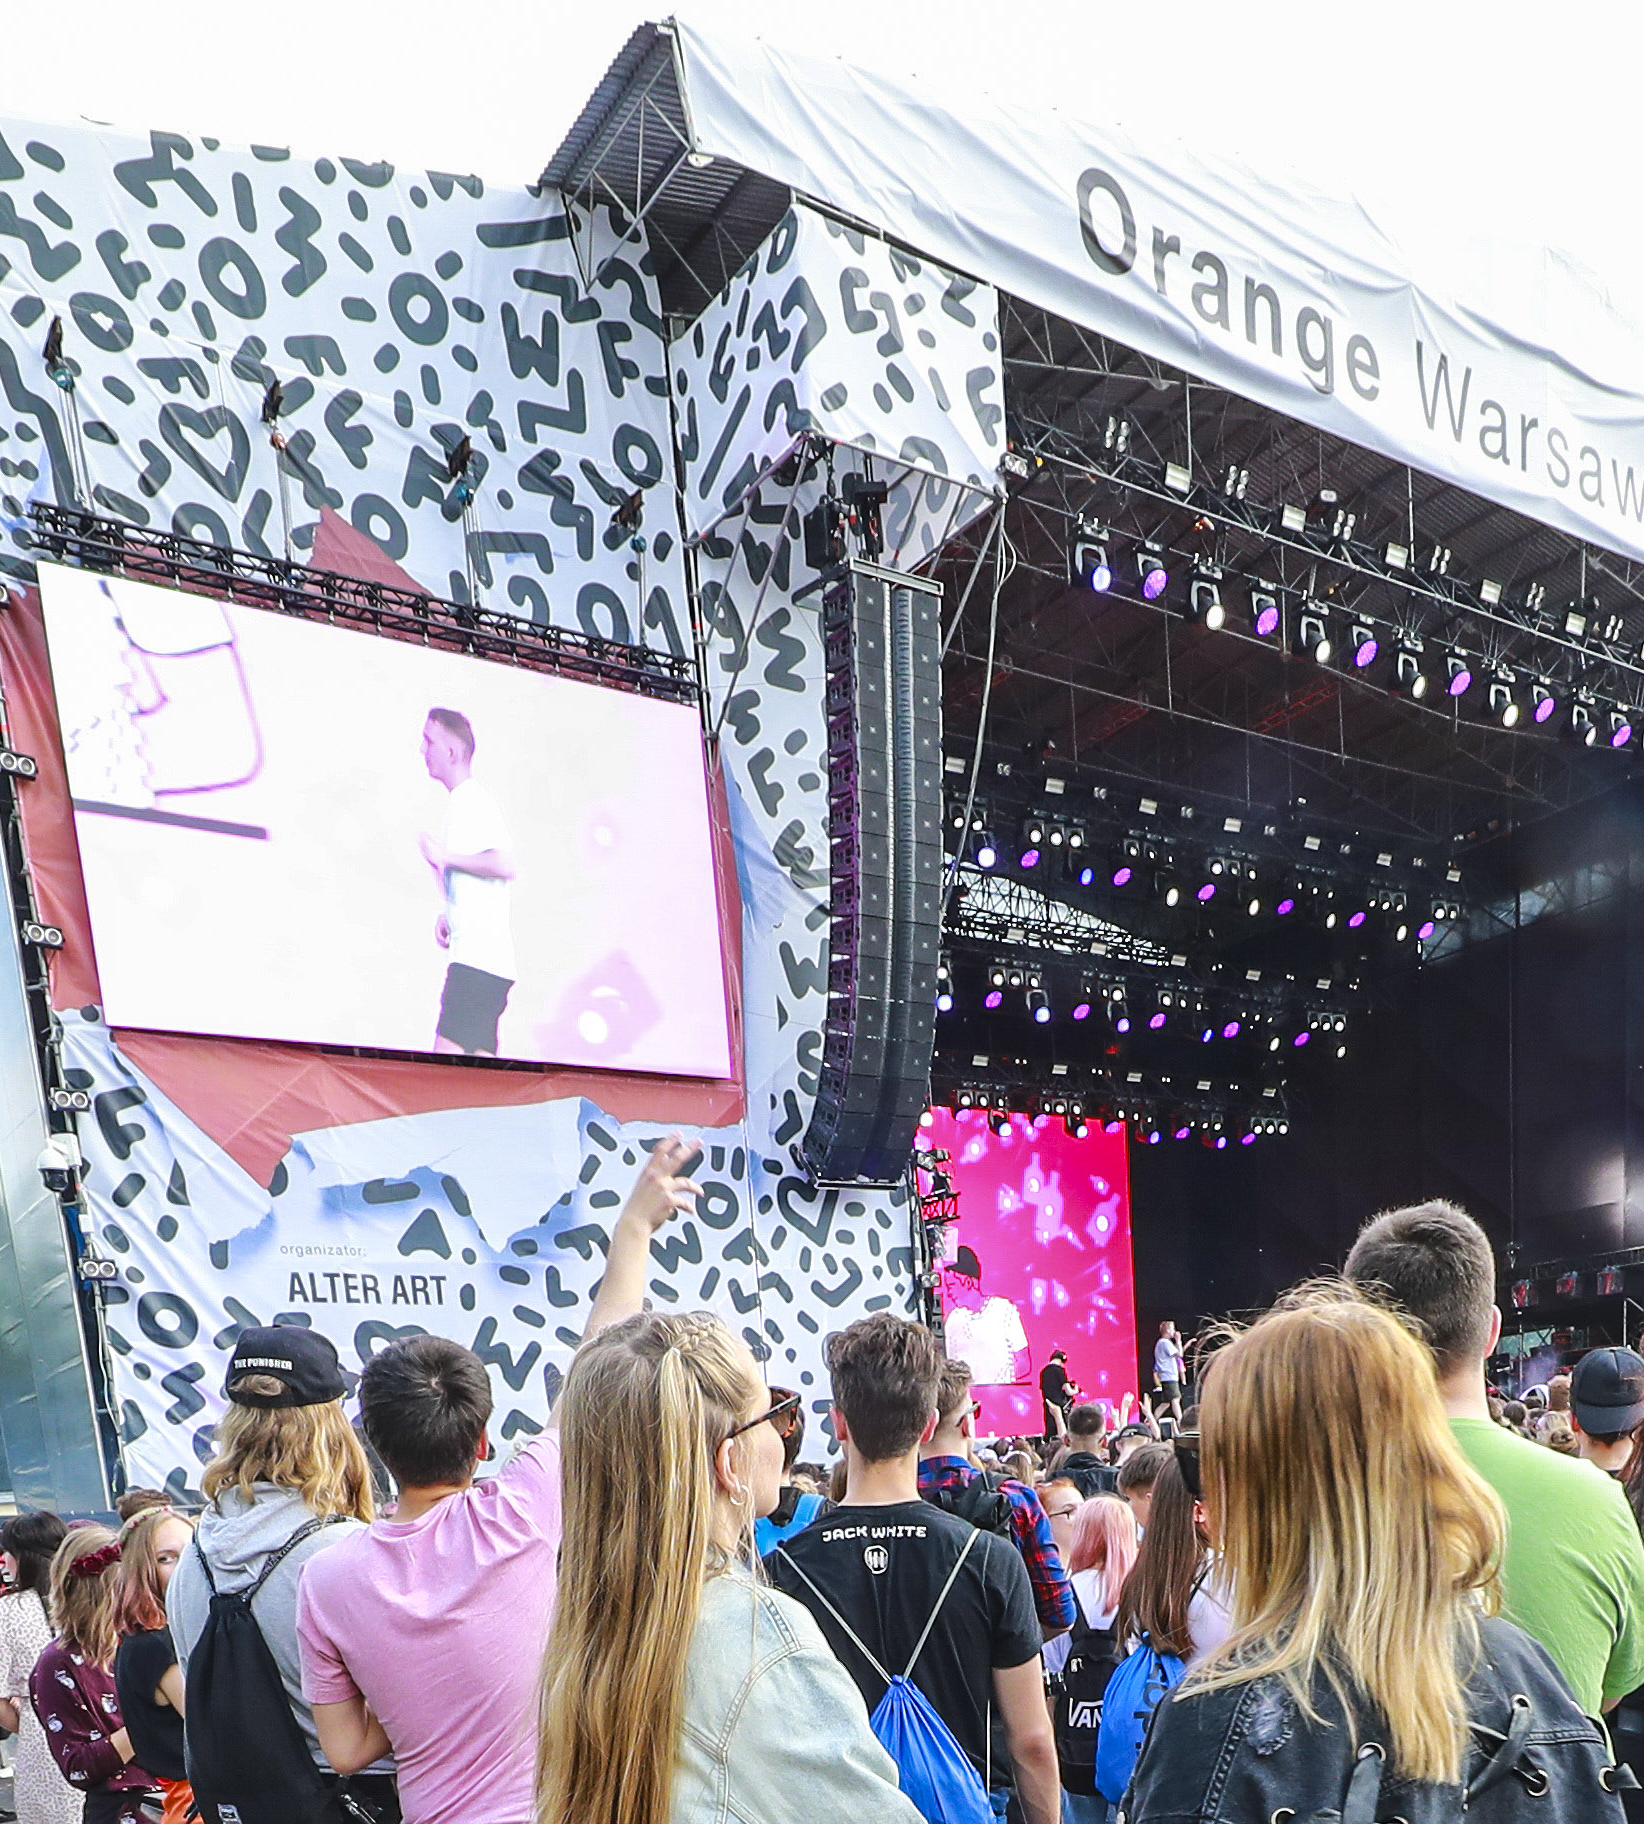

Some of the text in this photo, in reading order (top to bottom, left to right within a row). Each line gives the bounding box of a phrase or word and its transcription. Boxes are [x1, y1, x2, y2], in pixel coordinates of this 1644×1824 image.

[1075, 167, 1381, 402] Orange
[280, 1244, 367, 1258] organizator:
[289, 1271, 447, 1306] ALTER ART
[247, 1357, 293, 1371] PUNISHER
[822, 1525, 927, 1542] JACK WHITE
[1068, 1697, 1104, 1729] VAN
